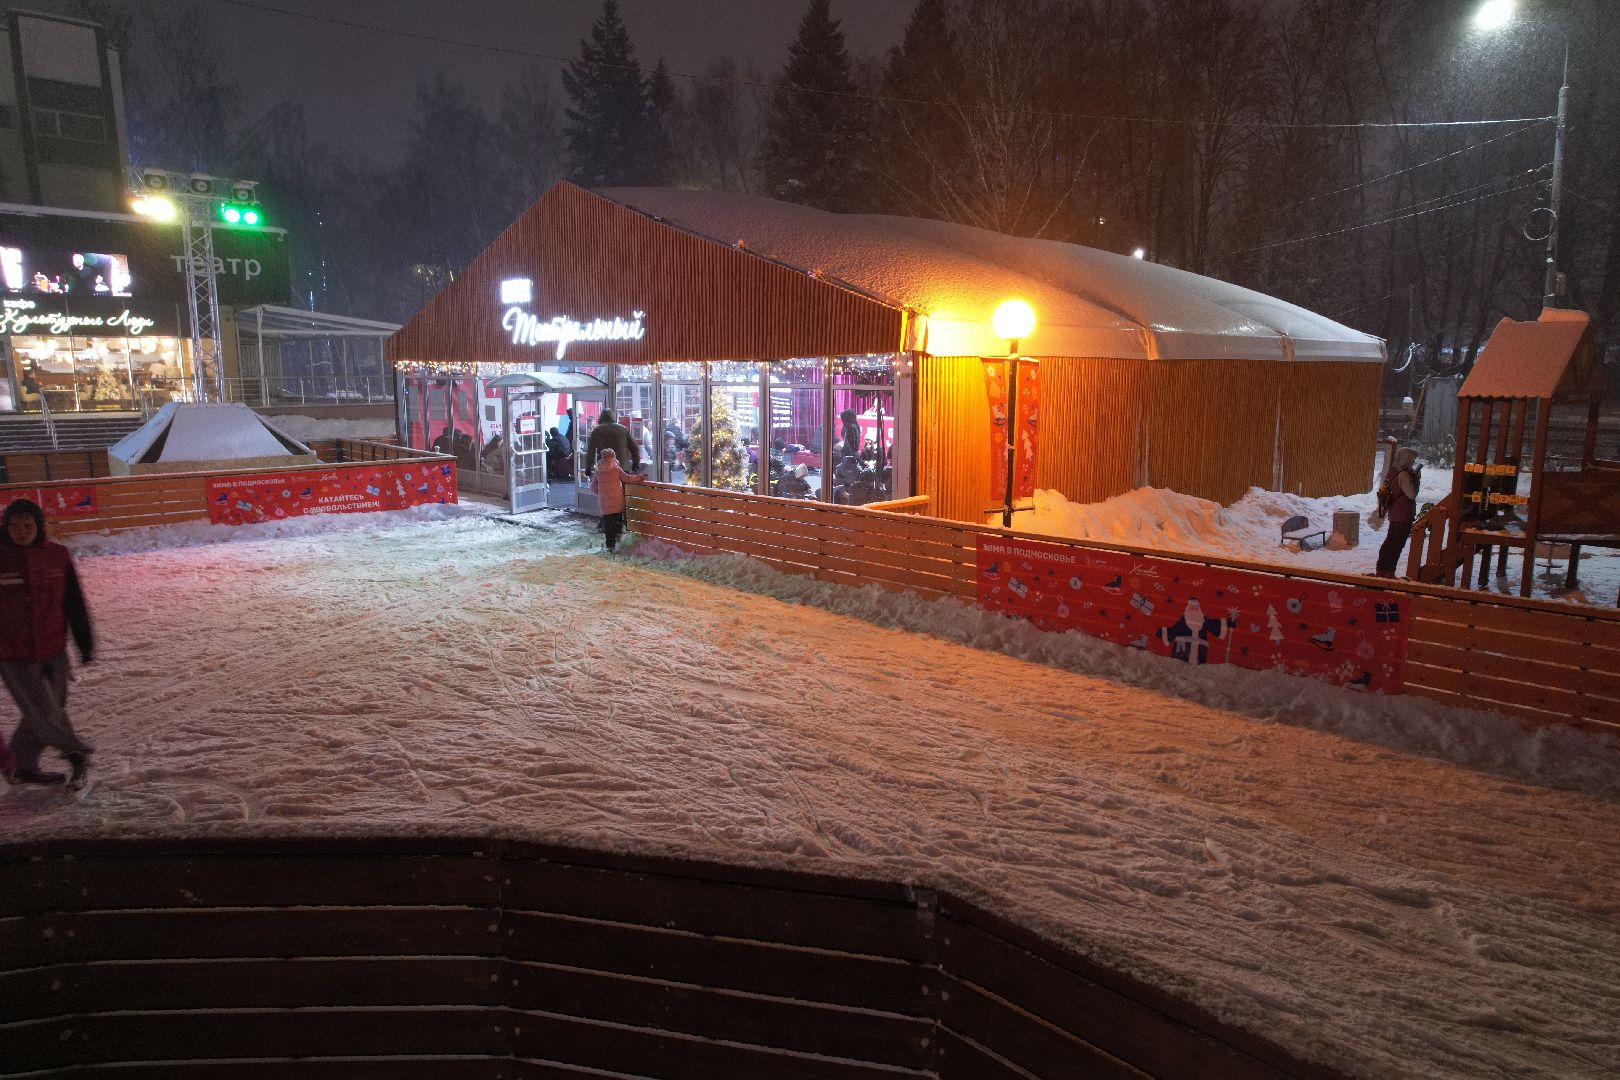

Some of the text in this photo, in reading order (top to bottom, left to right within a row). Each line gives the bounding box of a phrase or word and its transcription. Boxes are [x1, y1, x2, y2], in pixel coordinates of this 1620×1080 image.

[170, 254, 262, 280] театр
[502, 306, 646, 360] Театральный
[983, 543, 1005, 554] ЗИМА
[1013, 547, 1076, 564] ПОДМОСКОВЬЕ
